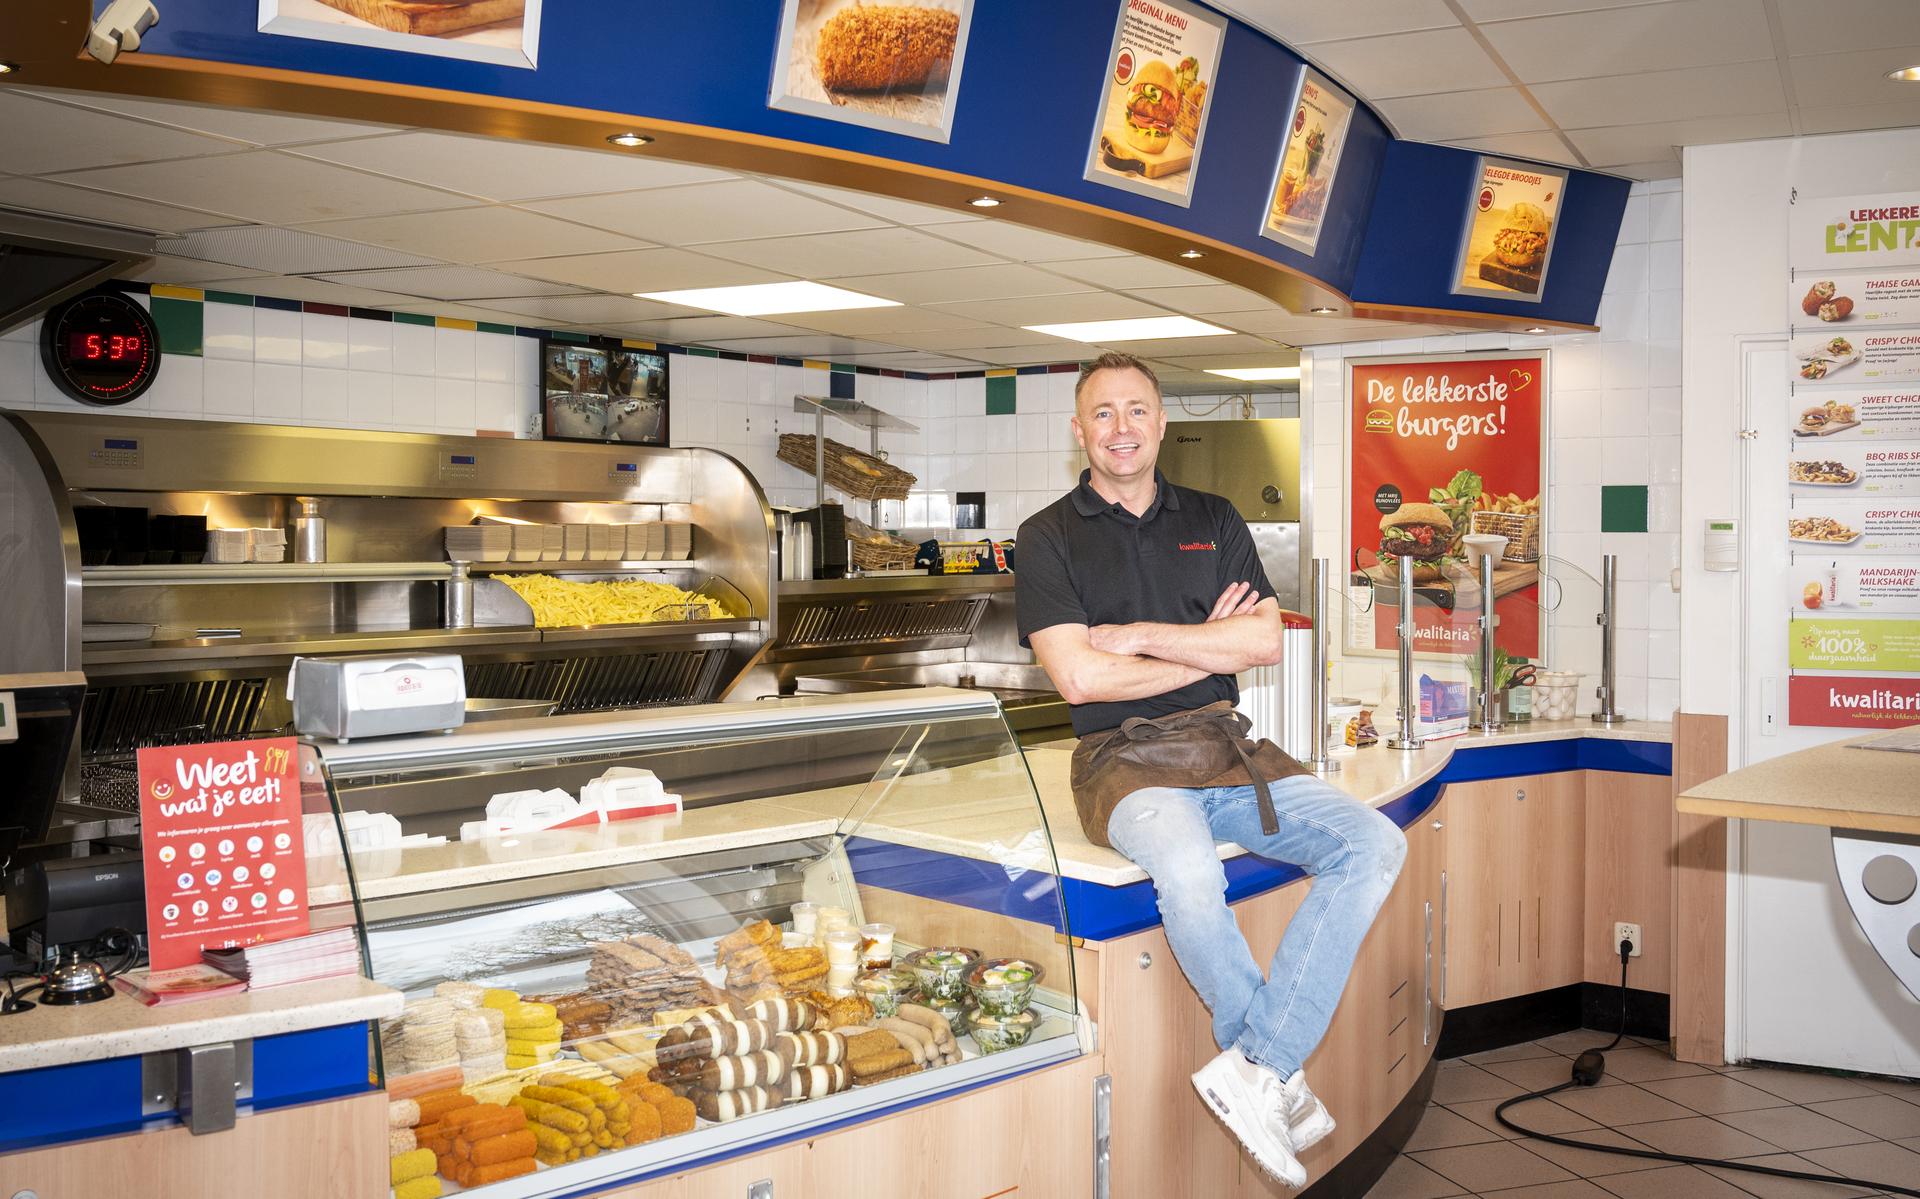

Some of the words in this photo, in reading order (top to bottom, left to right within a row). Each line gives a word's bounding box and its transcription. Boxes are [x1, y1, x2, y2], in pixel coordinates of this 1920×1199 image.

[1164, 12, 1188, 30] MENU
[1511, 173, 1542, 186] BROODJES
[1850, 206, 1920, 222] LEKKERE
[1866, 280, 1899, 289] THAISE
[1865, 337, 1898, 346] CRISPY
[1367, 379, 1395, 404] De
[1402, 375, 1508, 404] lekkerste
[1862, 396, 1892, 404] SWEET
[1396, 405, 1506, 451] burgers!
[1866, 452, 1886, 462] BBQ
[1888, 452, 1909, 460] RIBS
[1865, 510, 1898, 518] CRISPY
[1860, 569, 1920, 578] MANDARIJN-
[1414, 626, 1470, 642] walitaria
[1816, 637, 1867, 654] 100%
[1808, 652, 1877, 665] duurzaamheid
[176, 750, 260, 790] Weet
[160, 788, 208, 817] wat
[212, 788, 236, 817] je
[239, 777, 281, 806] eet!
[95, 873, 119, 882] EPSON
